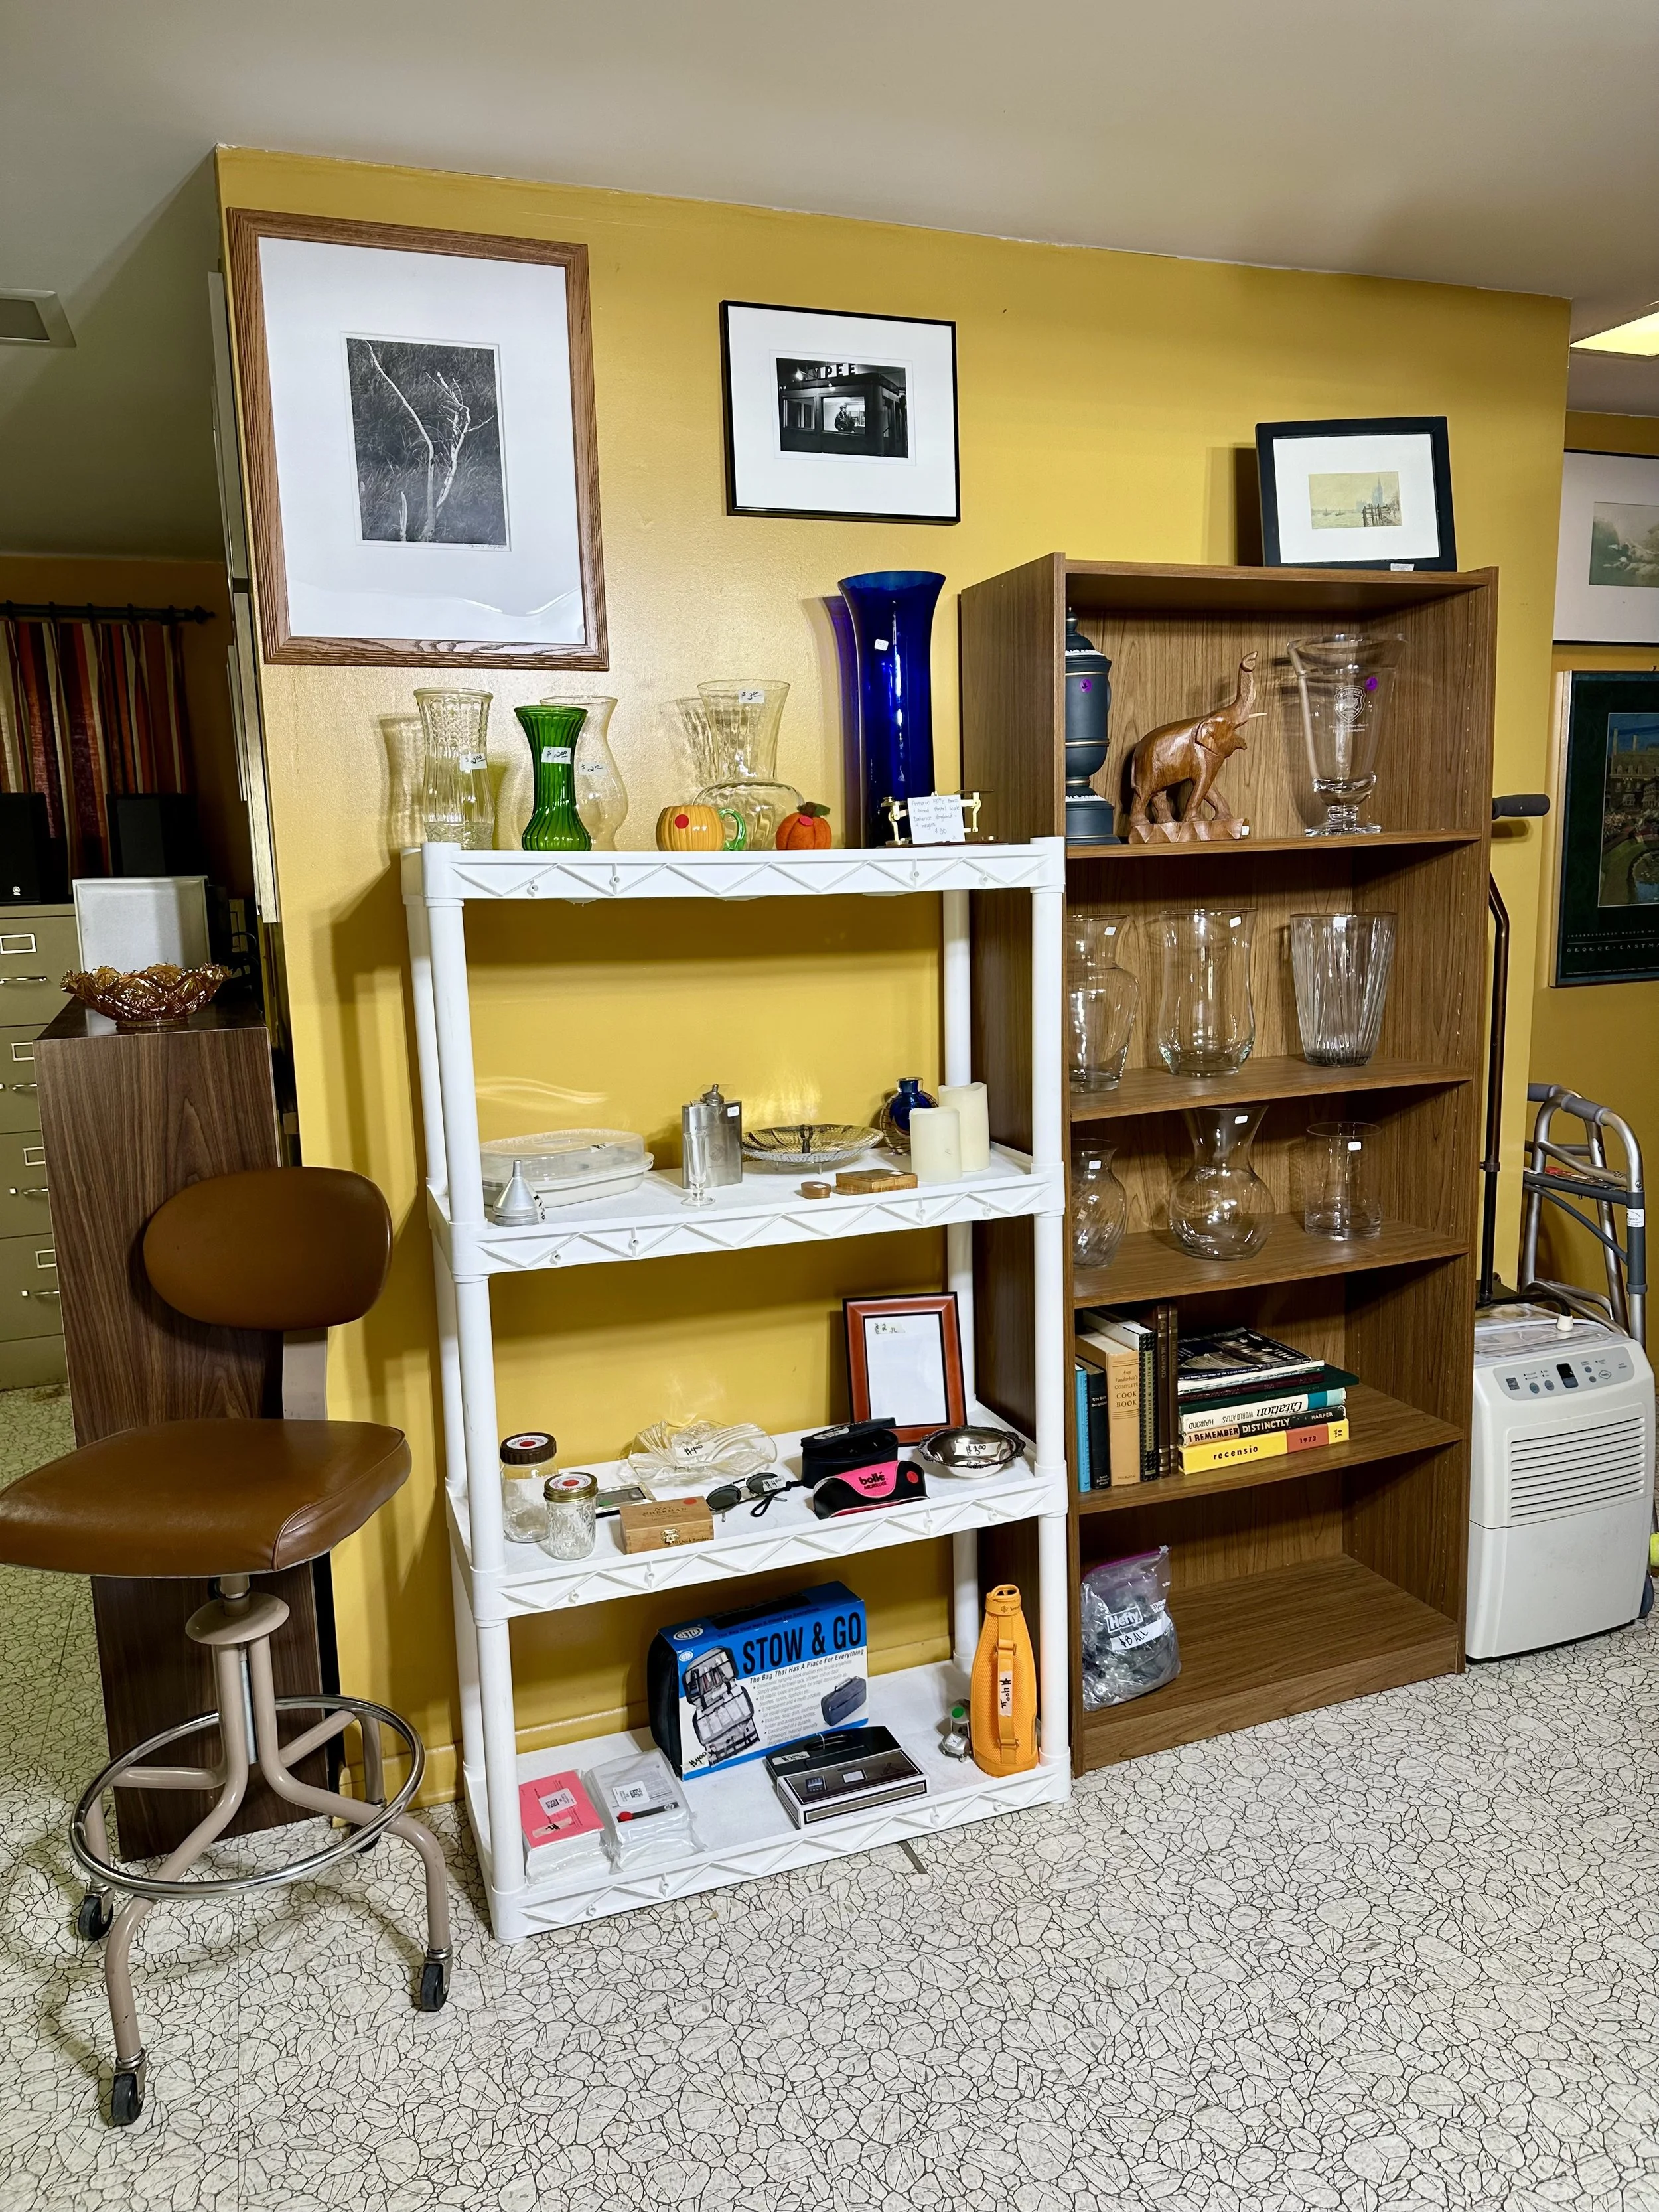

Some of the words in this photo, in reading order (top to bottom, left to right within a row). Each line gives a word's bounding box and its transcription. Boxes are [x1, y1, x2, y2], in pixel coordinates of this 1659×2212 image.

[1116, 1399, 1137, 1408] BOOK
[1256, 1401, 1302, 1419] Citation
[1194, 1427, 1239, 1441] REMEMBER
[1242, 1418, 1290, 1434] DISTINCTLY
[1311, 1412, 1333, 1420] HARPER
[1213, 1445, 1258, 1461] recensio
[1299, 1435, 1317, 1444] 1973
[858, 1471, 886, 1485] bollé
[642, 1507, 687, 1516] SHERMAN
[1109, 1611, 1140, 1629] Hefty
[743, 1626, 804, 1674] STOW
[811, 1621, 826, 1656] &
[833, 1611, 862, 1651] GO
[1133, 1630, 1148, 1643] ALL
[761, 1672, 773, 1682] Bag
[775, 1668, 788, 1678] That
[807, 1660, 823, 1668] Place
[835, 1649, 865, 1660] Everything
